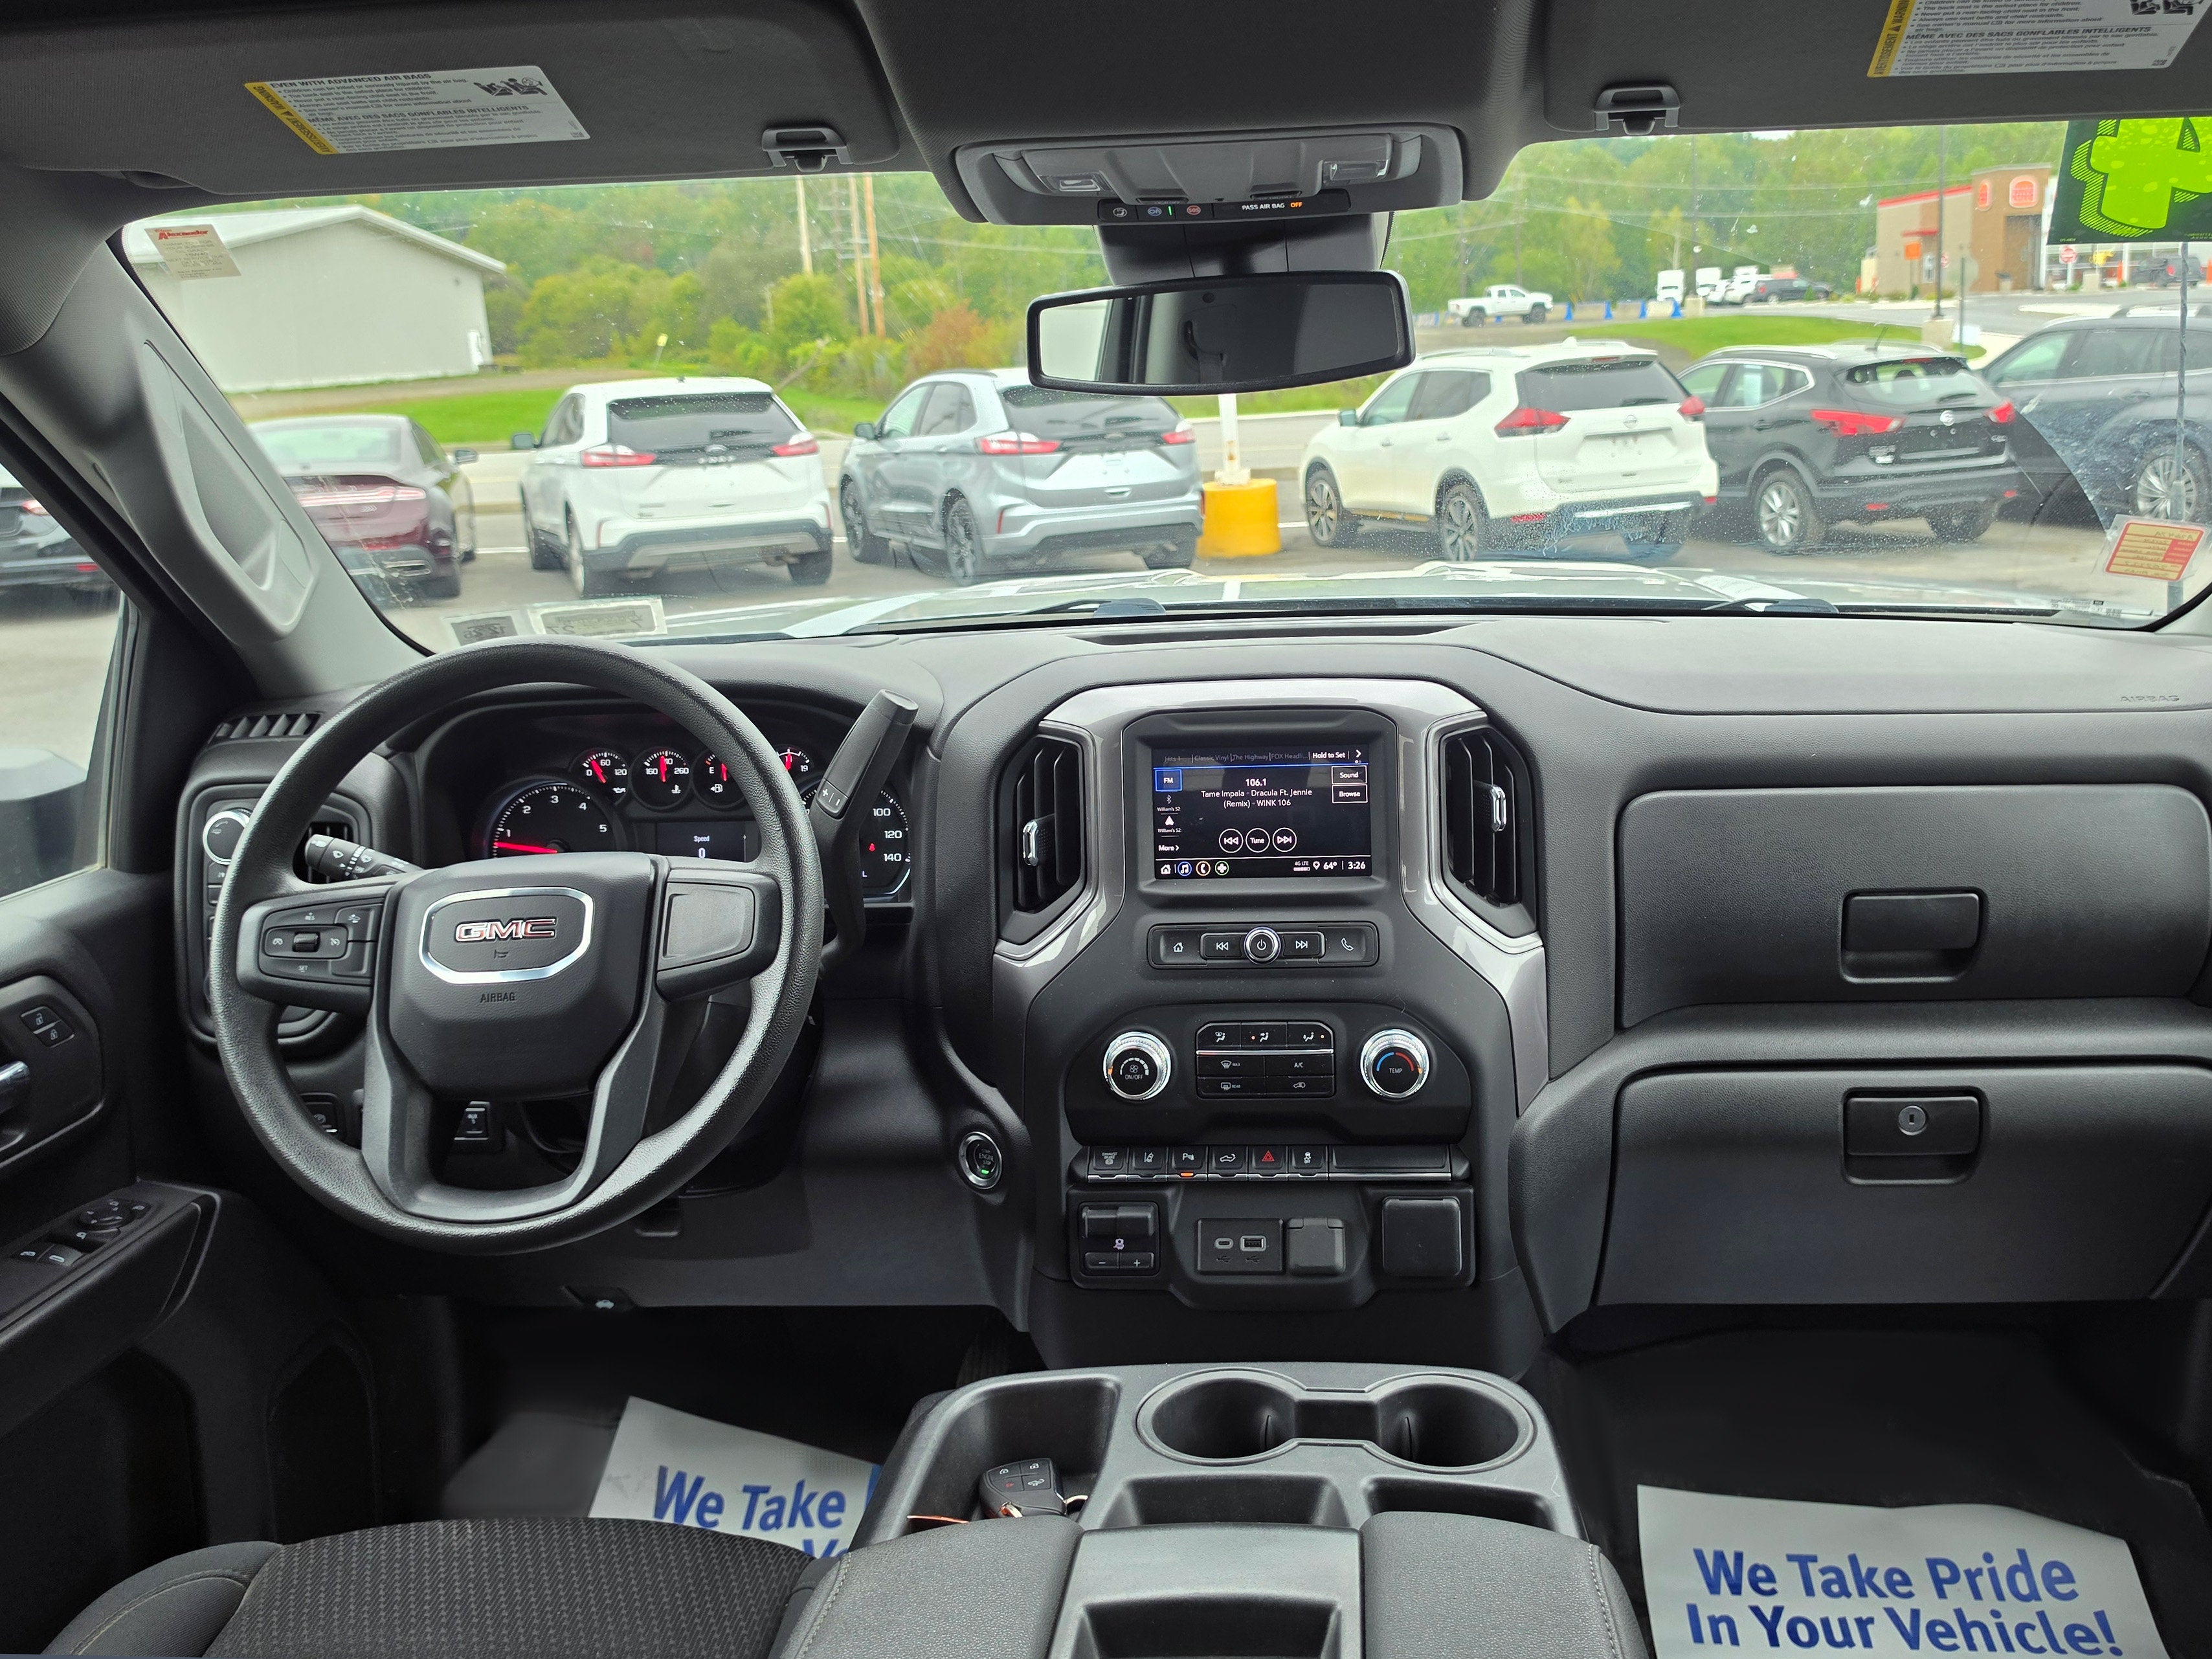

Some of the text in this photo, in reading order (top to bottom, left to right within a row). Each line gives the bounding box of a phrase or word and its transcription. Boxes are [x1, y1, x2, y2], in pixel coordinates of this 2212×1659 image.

[328, 76, 382, 85] ADVANCED
[1215, 753, 1229, 762] Vinyl
[1244, 753, 1268, 762] Highway
[1222, 790, 1245, 799] Impala
[1290, 788, 1312, 797] Jennie
[551, 795, 559, 803] 3
[579, 802, 587, 810] 4
[1223, 799, 1251, 809] (Remix)
[522, 805, 531, 814] 2
[873, 808, 891, 817] 100
[599, 824, 607, 832] 5
[506, 829, 511, 838] 1
[884, 830, 902, 839] 120
[698, 847, 706, 859] 0
[884, 853, 902, 862] 140
[1348, 861, 1366, 869] 3:26
[454, 918, 557, 942] GMC
[480, 992, 516, 1003] AIRBAG
[653, 1465, 846, 1532] We Take
[1692, 1548, 2079, 1603] We Take Pride
[1686, 1603, 2124, 1657] In Your Vehicle!
